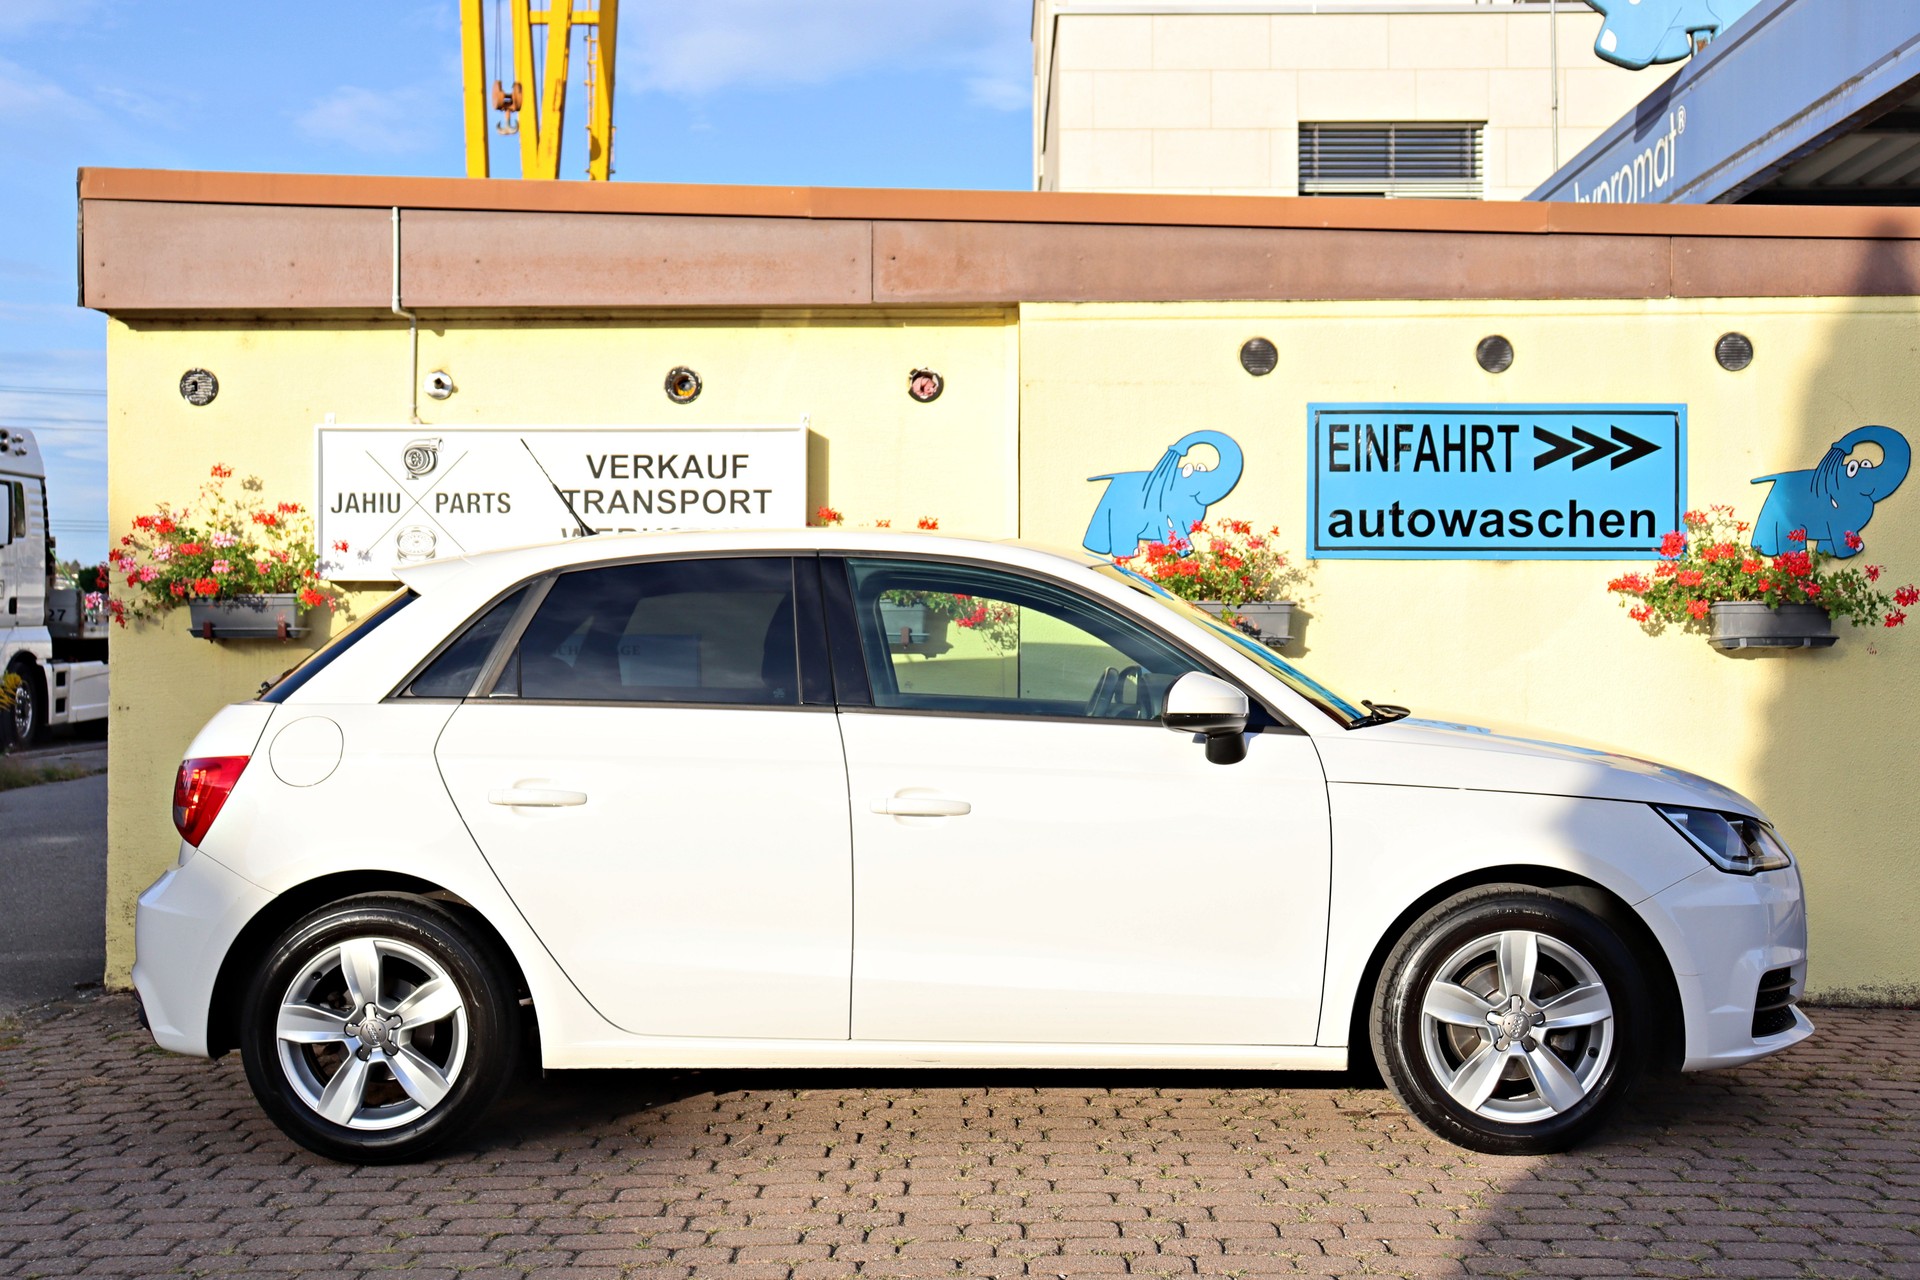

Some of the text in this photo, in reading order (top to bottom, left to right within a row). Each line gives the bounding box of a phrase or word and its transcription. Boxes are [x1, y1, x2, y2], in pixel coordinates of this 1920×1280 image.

[1328, 423, 1520, 473] EINFAHRT
[585, 453, 750, 480] VERKAUF
[330, 492, 511, 514] JAHIU PARTS
[561, 488, 773, 514] TRANSPORT
[1327, 499, 1656, 539] autowaschen
